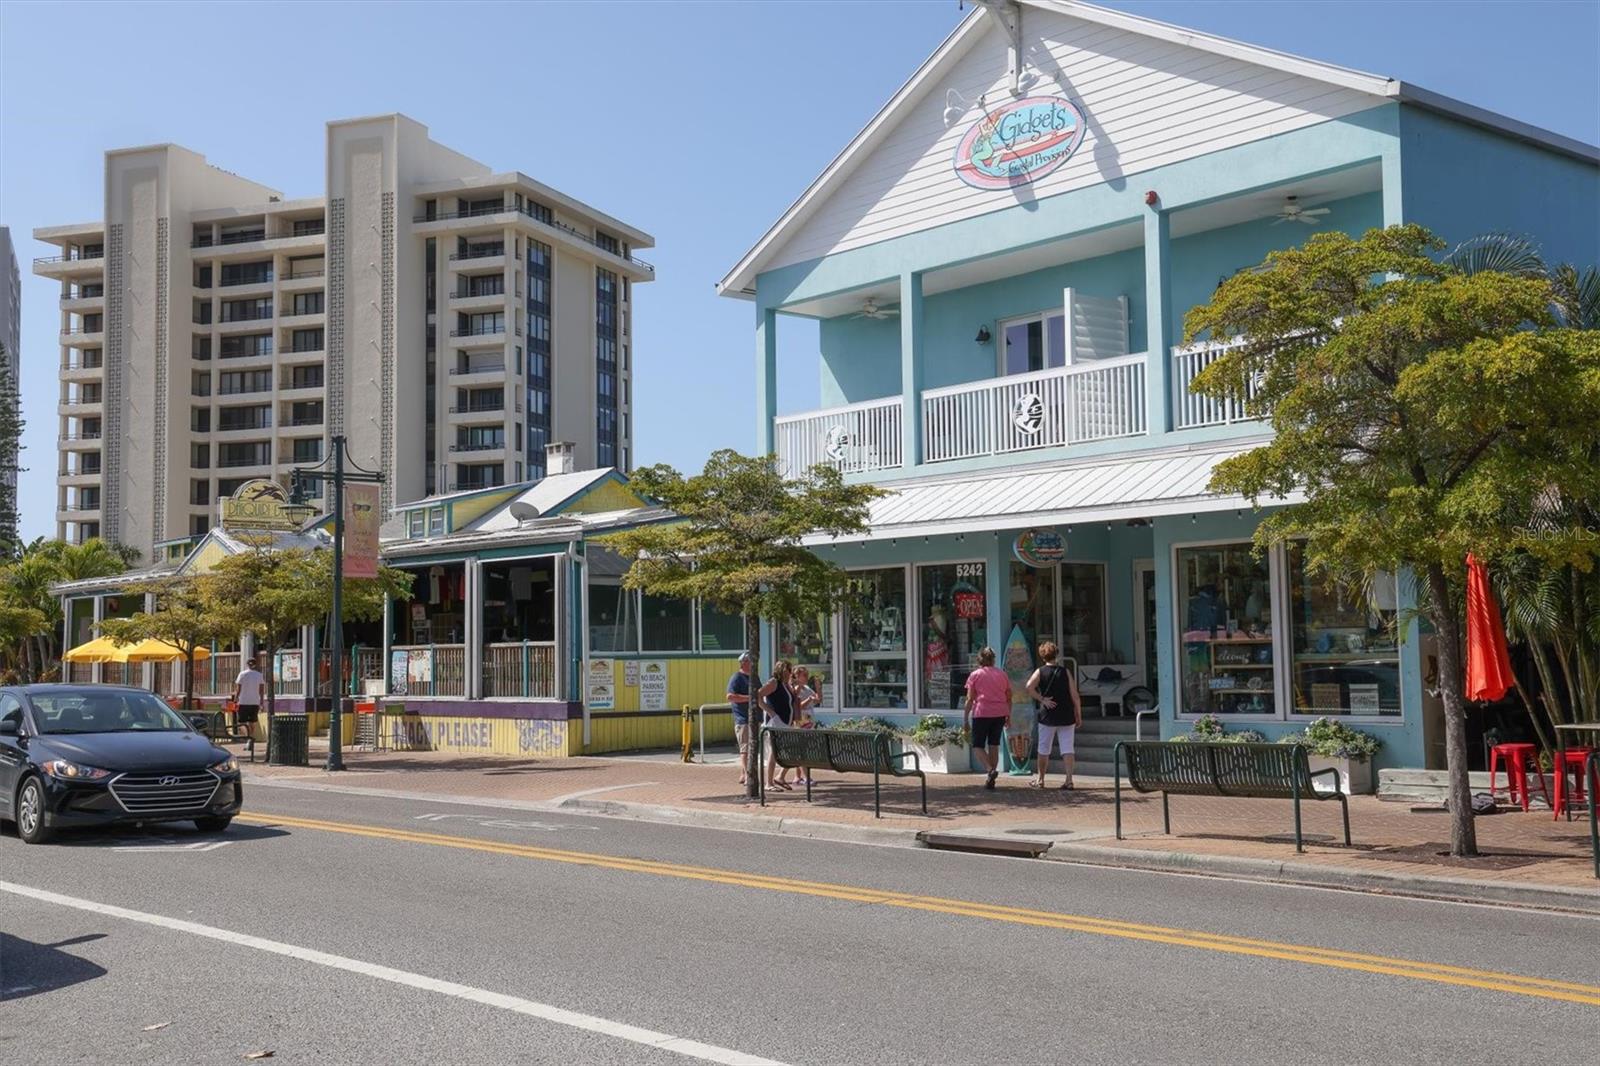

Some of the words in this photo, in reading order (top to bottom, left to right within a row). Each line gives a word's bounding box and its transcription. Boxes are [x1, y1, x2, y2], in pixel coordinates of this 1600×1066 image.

[956, 563, 983, 577] 5242
[960, 599, 982, 615] OPEN
[438, 721, 493, 747] PLEASE!
